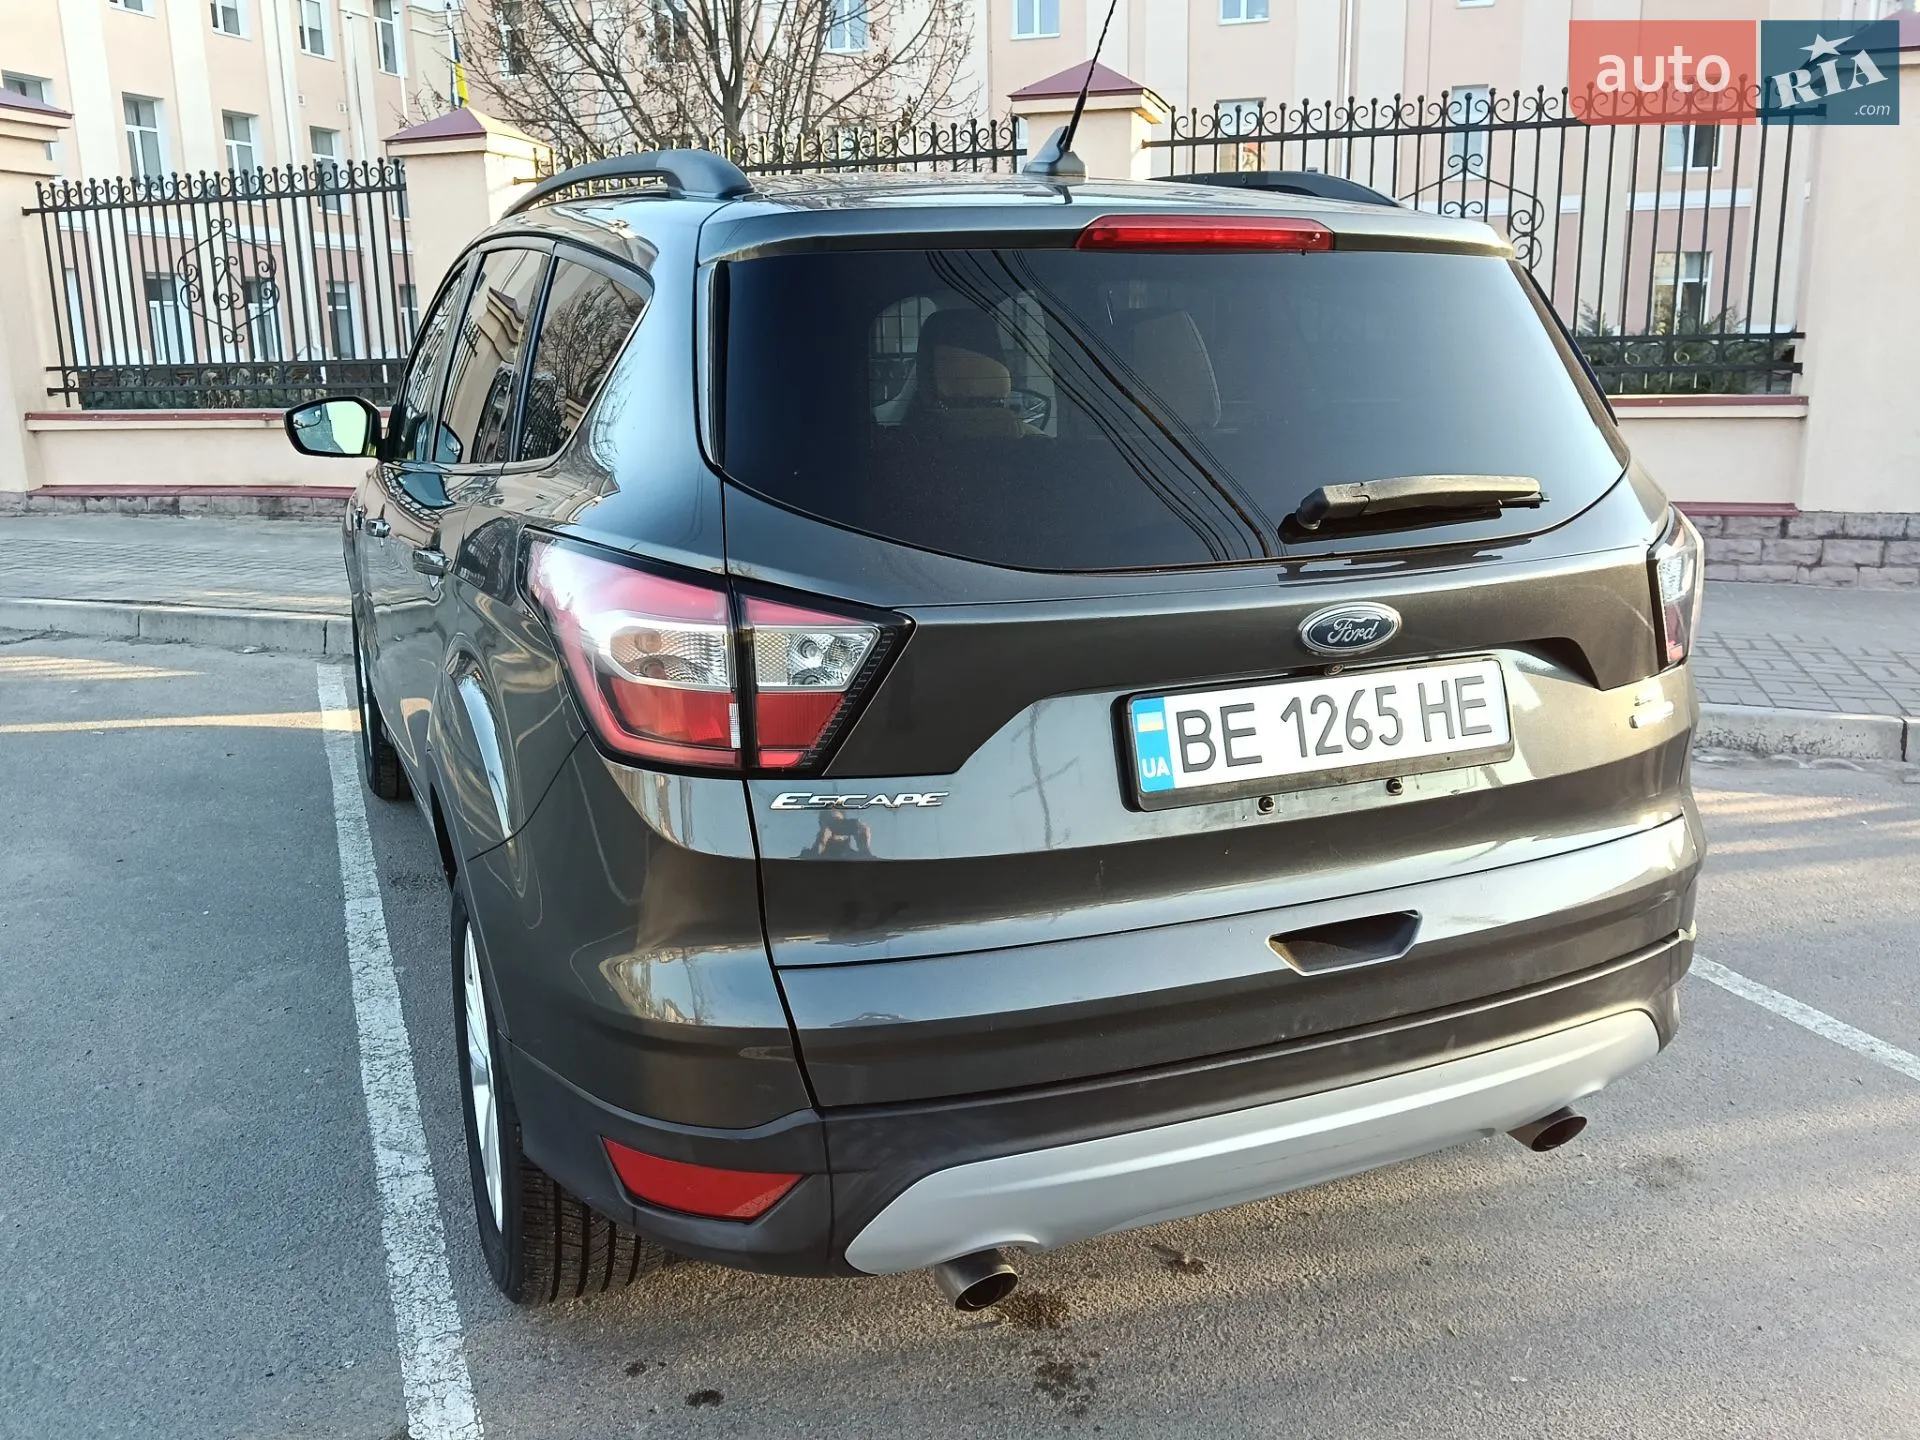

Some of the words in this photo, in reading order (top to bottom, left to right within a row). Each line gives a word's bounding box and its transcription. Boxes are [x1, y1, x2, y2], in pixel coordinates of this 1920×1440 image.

[1327, 616, 1379, 645] Ford
[1175, 702, 1263, 773] BE
[1280, 685, 1404, 758] 1265
[1417, 674, 1492, 742] HE
[1142, 757, 1170, 779] UA
[770, 791, 949, 810] ESCAPE
